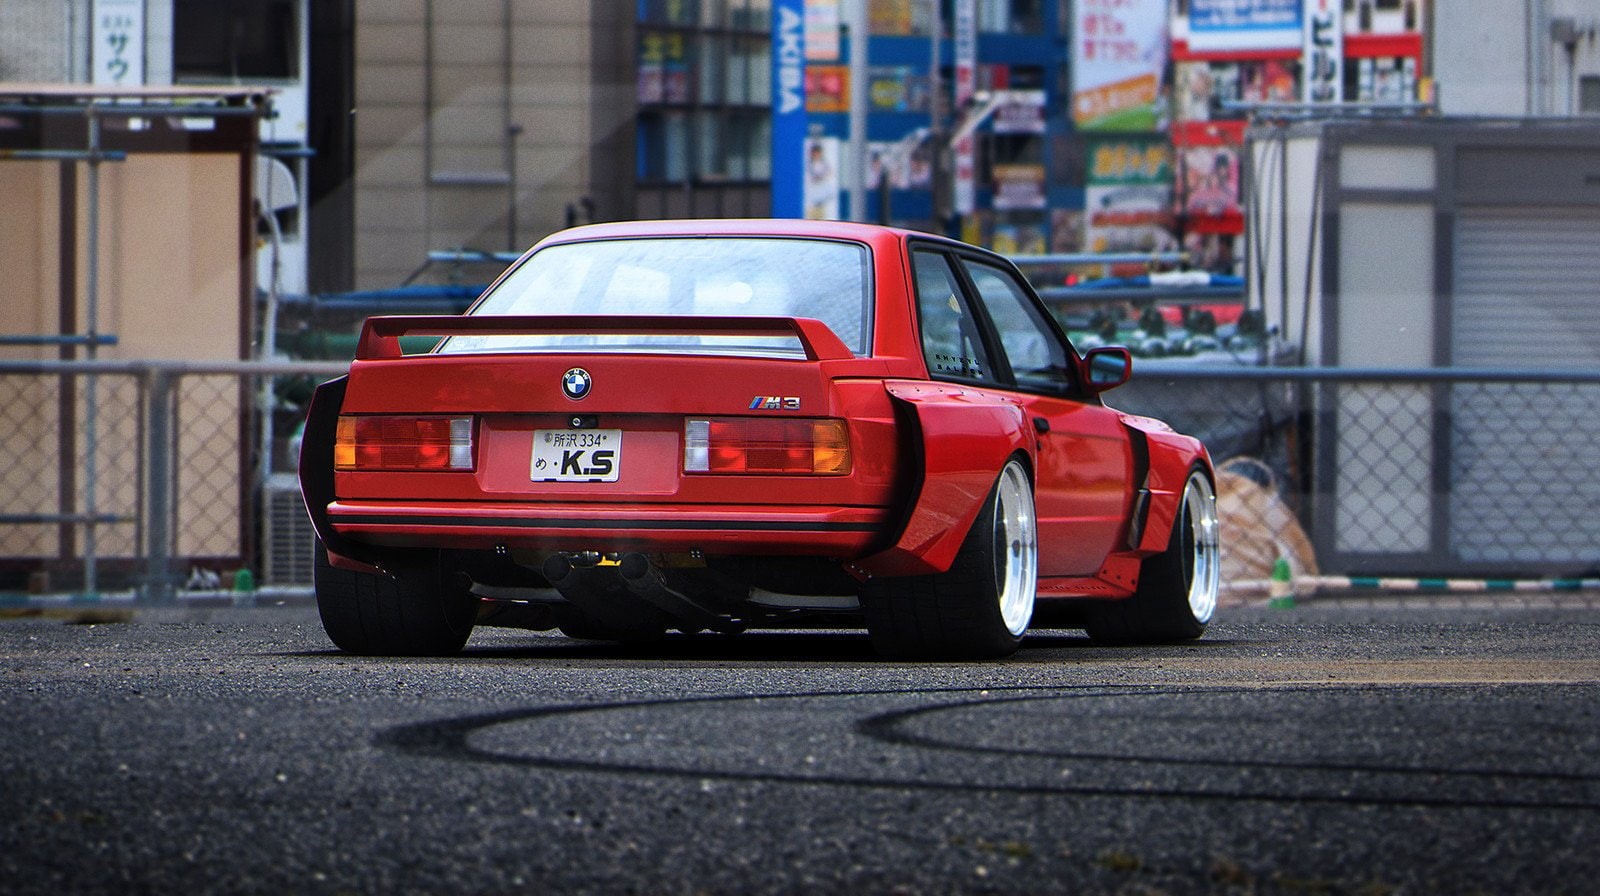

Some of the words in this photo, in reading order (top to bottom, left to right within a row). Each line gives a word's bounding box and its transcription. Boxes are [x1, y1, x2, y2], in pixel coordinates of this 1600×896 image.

[779, 6, 801, 114] AKIBA
[553, 433, 577, 447] 所沢
[579, 433, 601, 447] 334
